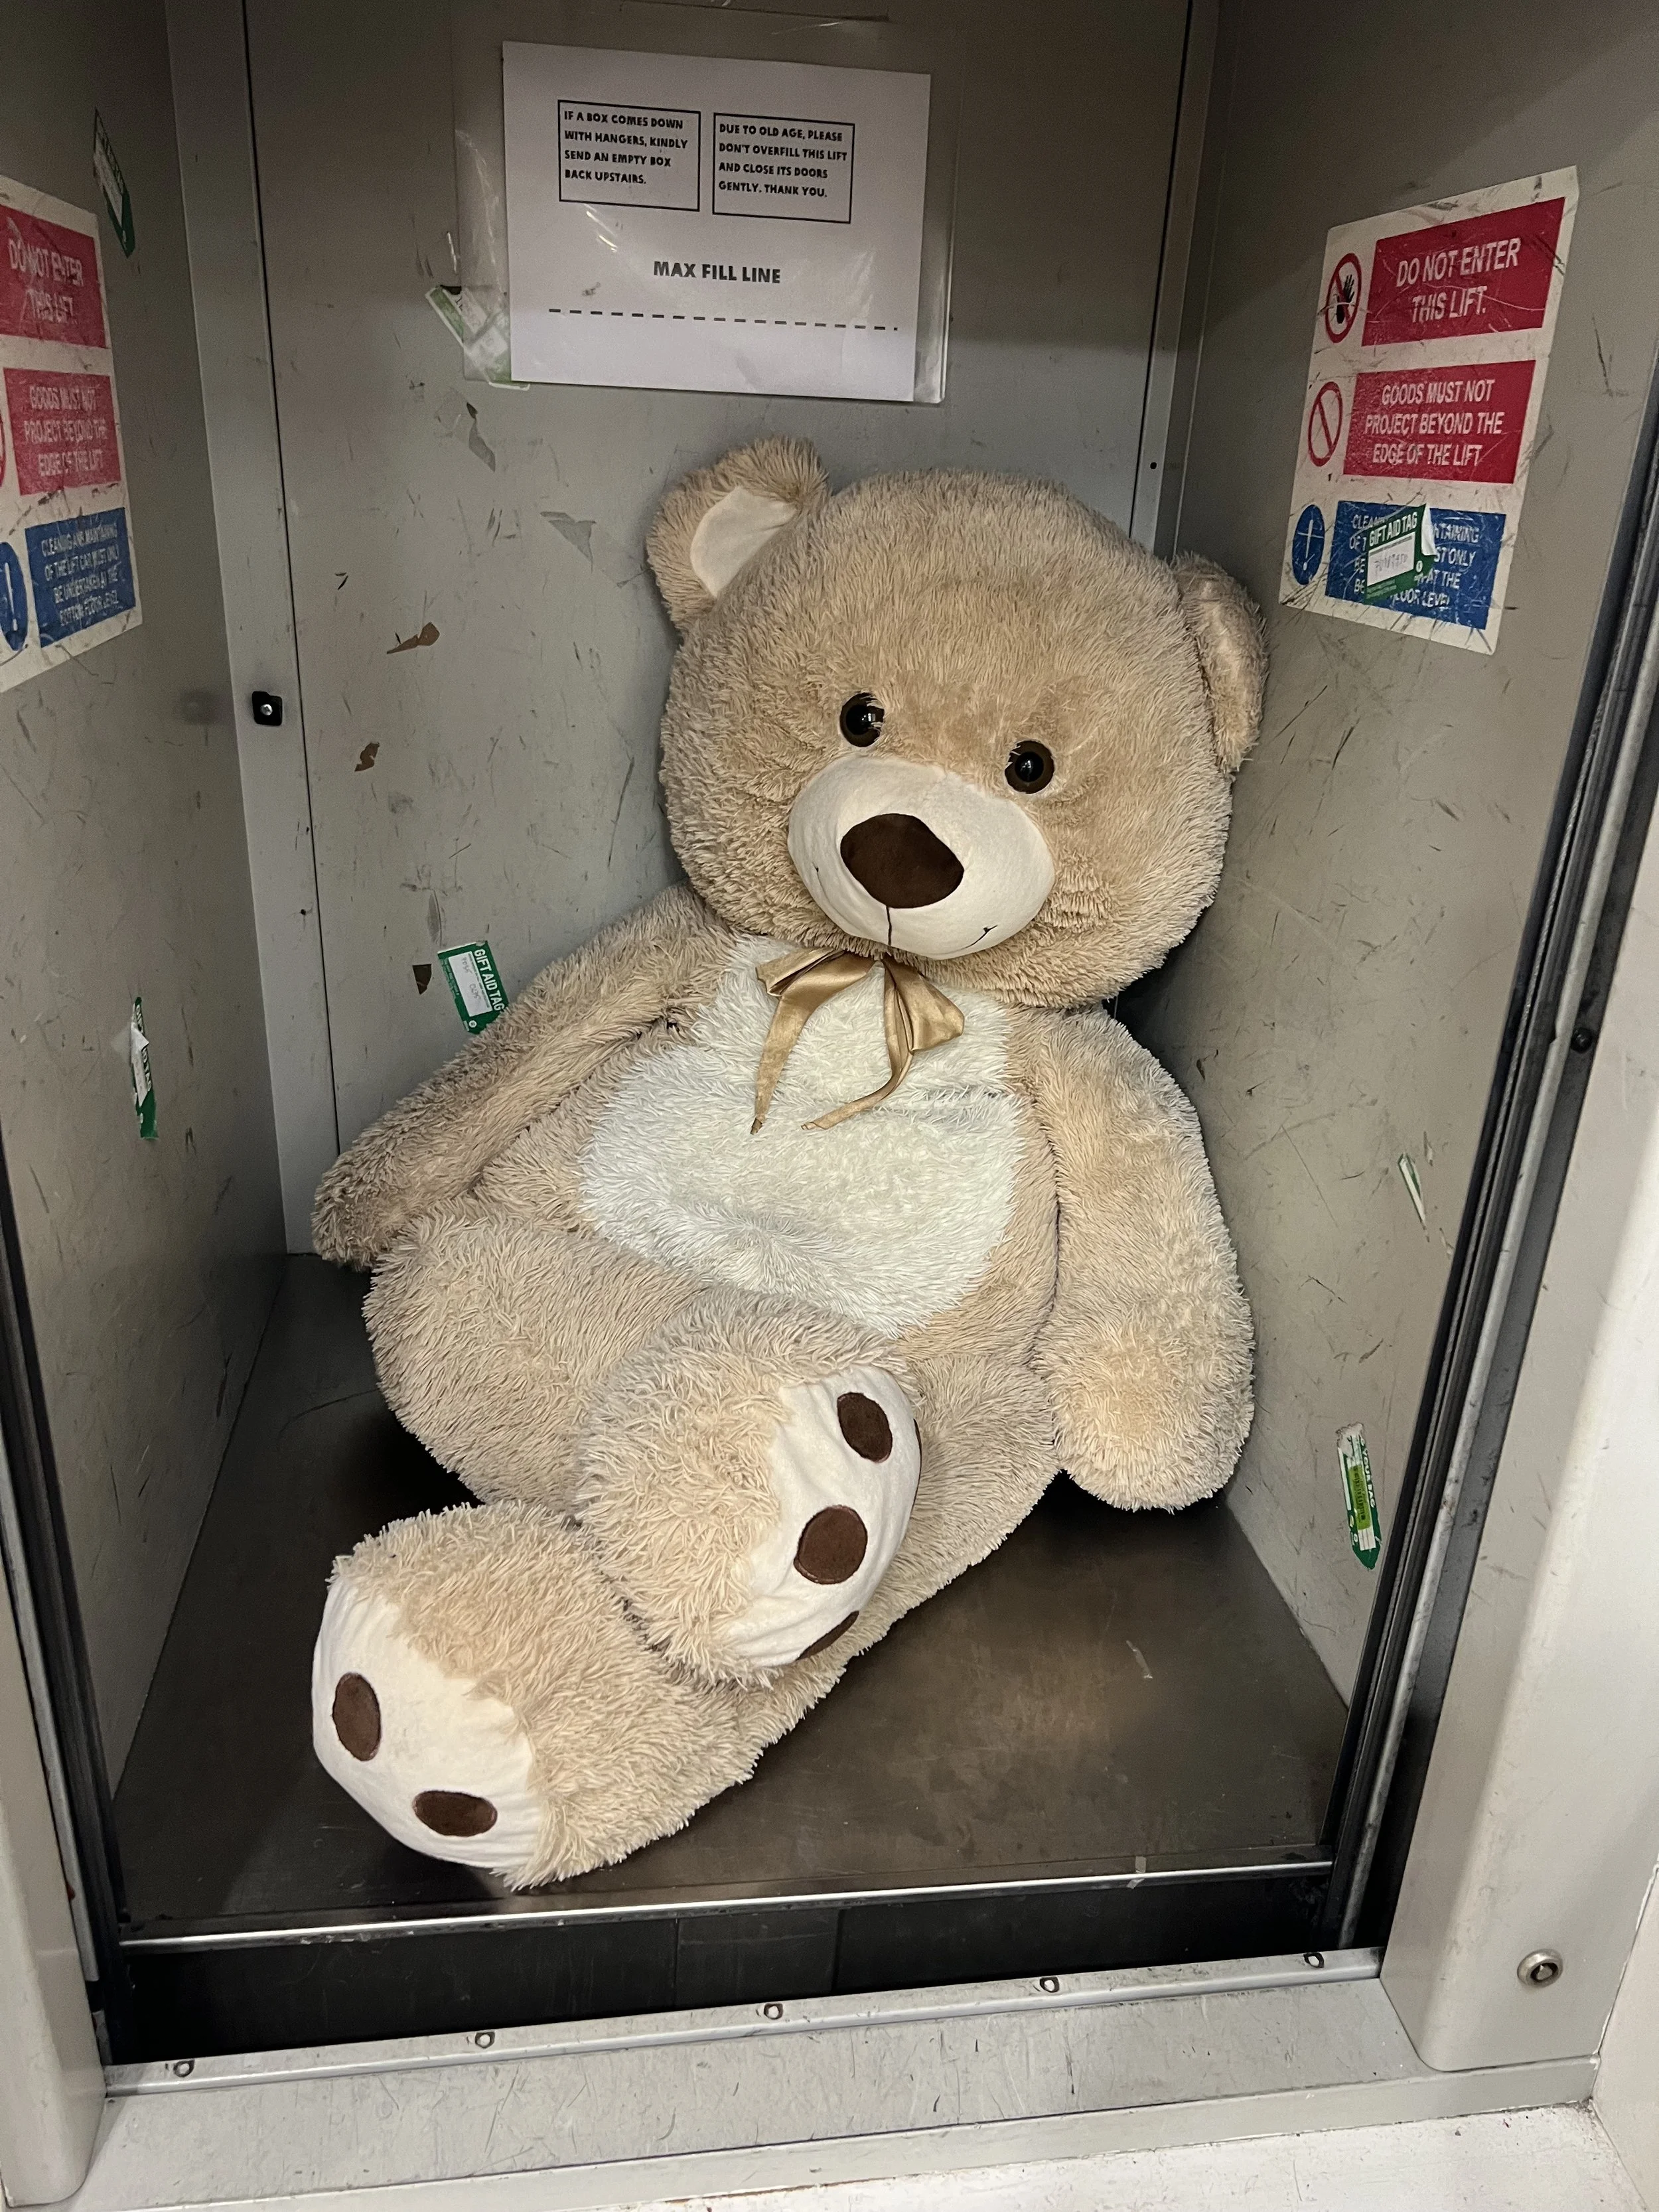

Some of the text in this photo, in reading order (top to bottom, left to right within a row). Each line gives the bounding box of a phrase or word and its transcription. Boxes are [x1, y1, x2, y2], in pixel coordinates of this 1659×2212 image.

[564, 111, 683, 129] IF A BOX COMES DOWN
[565, 130, 687, 149] WITH HANGERS, KINDLY
[719, 123, 843, 141] DUE TO OLD AGE, PLEASE
[565, 149, 671, 167] SEND AN EMPTY BOX
[719, 143, 847, 161] DON'T OVERFILL THIS LIFT
[565, 169, 647, 184] BACK UPSTAIRS.
[719, 162, 828, 179] AND CLOSE ITS DOORS
[719, 181, 828, 198] GENTLY. THANK YOU.
[1396, 237, 1521, 287] DO NOT ENTER
[654, 261, 781, 284] MAX FILL LINE
[1412, 291, 1447, 323] THIS
[1382, 379, 1496, 406] GOODS MUST NOT
[1364, 411, 1505, 435] PROJECT BEYOND THE
[1372, 443, 1483, 466] EDGE OF THE LIFT
[1369, 524, 1387, 547] GIFT
[1386, 518, 1403, 540] AID
[1402, 511, 1418, 537] TAG
[1448, 548, 1477, 566] ONLY
[1441, 571, 1462, 589] THE
[474, 948, 492, 972] GIFT
[482, 974, 498, 991] AID
[489, 990, 505, 1011] TAG
